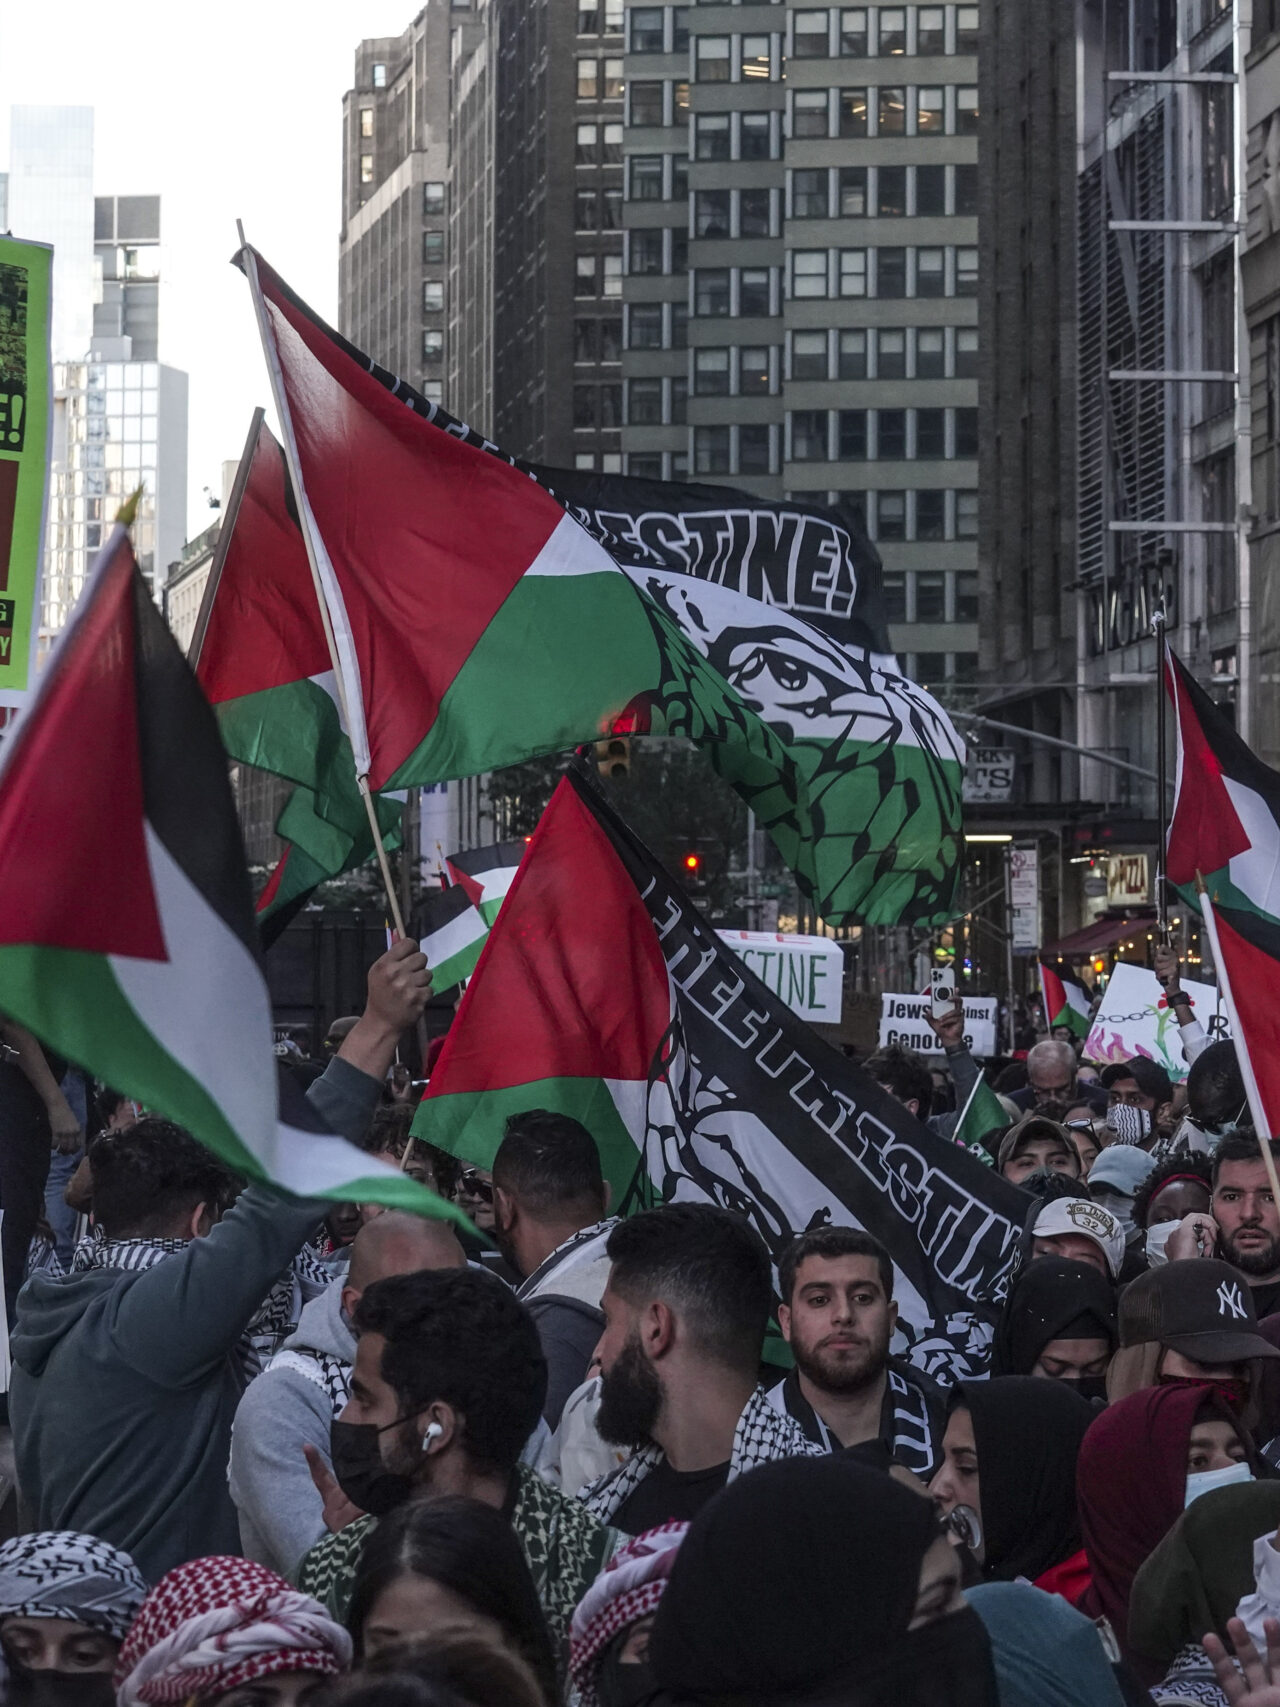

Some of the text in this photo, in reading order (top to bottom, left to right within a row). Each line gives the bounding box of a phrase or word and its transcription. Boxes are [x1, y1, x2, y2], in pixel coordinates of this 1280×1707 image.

[888, 1000, 932, 1019] Jews
[1082, 1217, 1099, 1230] 32
[1216, 1280, 1248, 1319] NY
